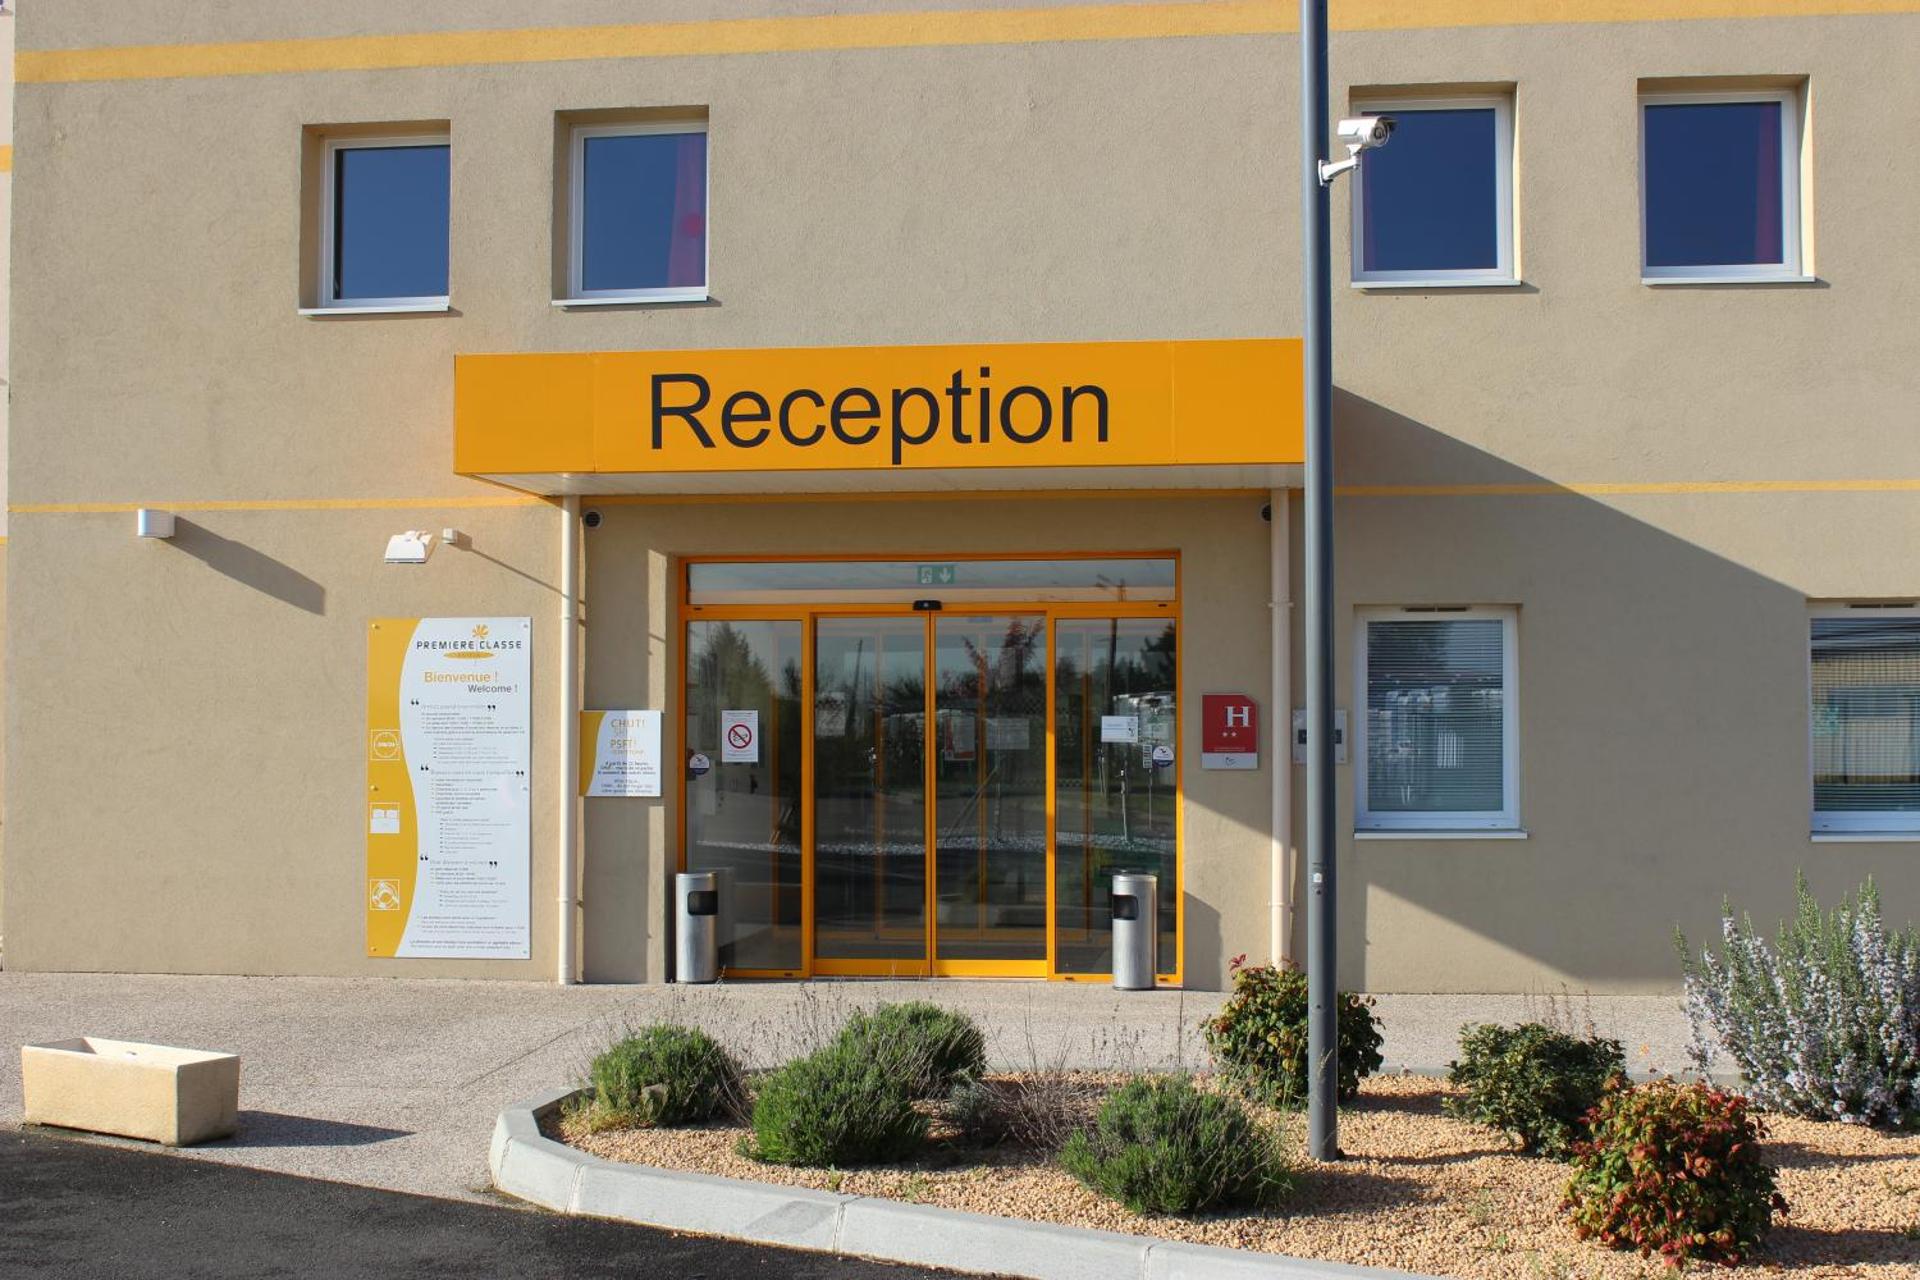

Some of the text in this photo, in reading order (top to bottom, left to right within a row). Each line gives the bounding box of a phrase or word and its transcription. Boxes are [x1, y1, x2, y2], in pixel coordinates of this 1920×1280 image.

[651, 367, 1109, 465] Reception
[416, 640, 522, 650] PREMIERE CLASSE
[424, 671, 491, 683] Bienvenue
[467, 684, 512, 693] Welcome
[1225, 706, 1252, 727] H
